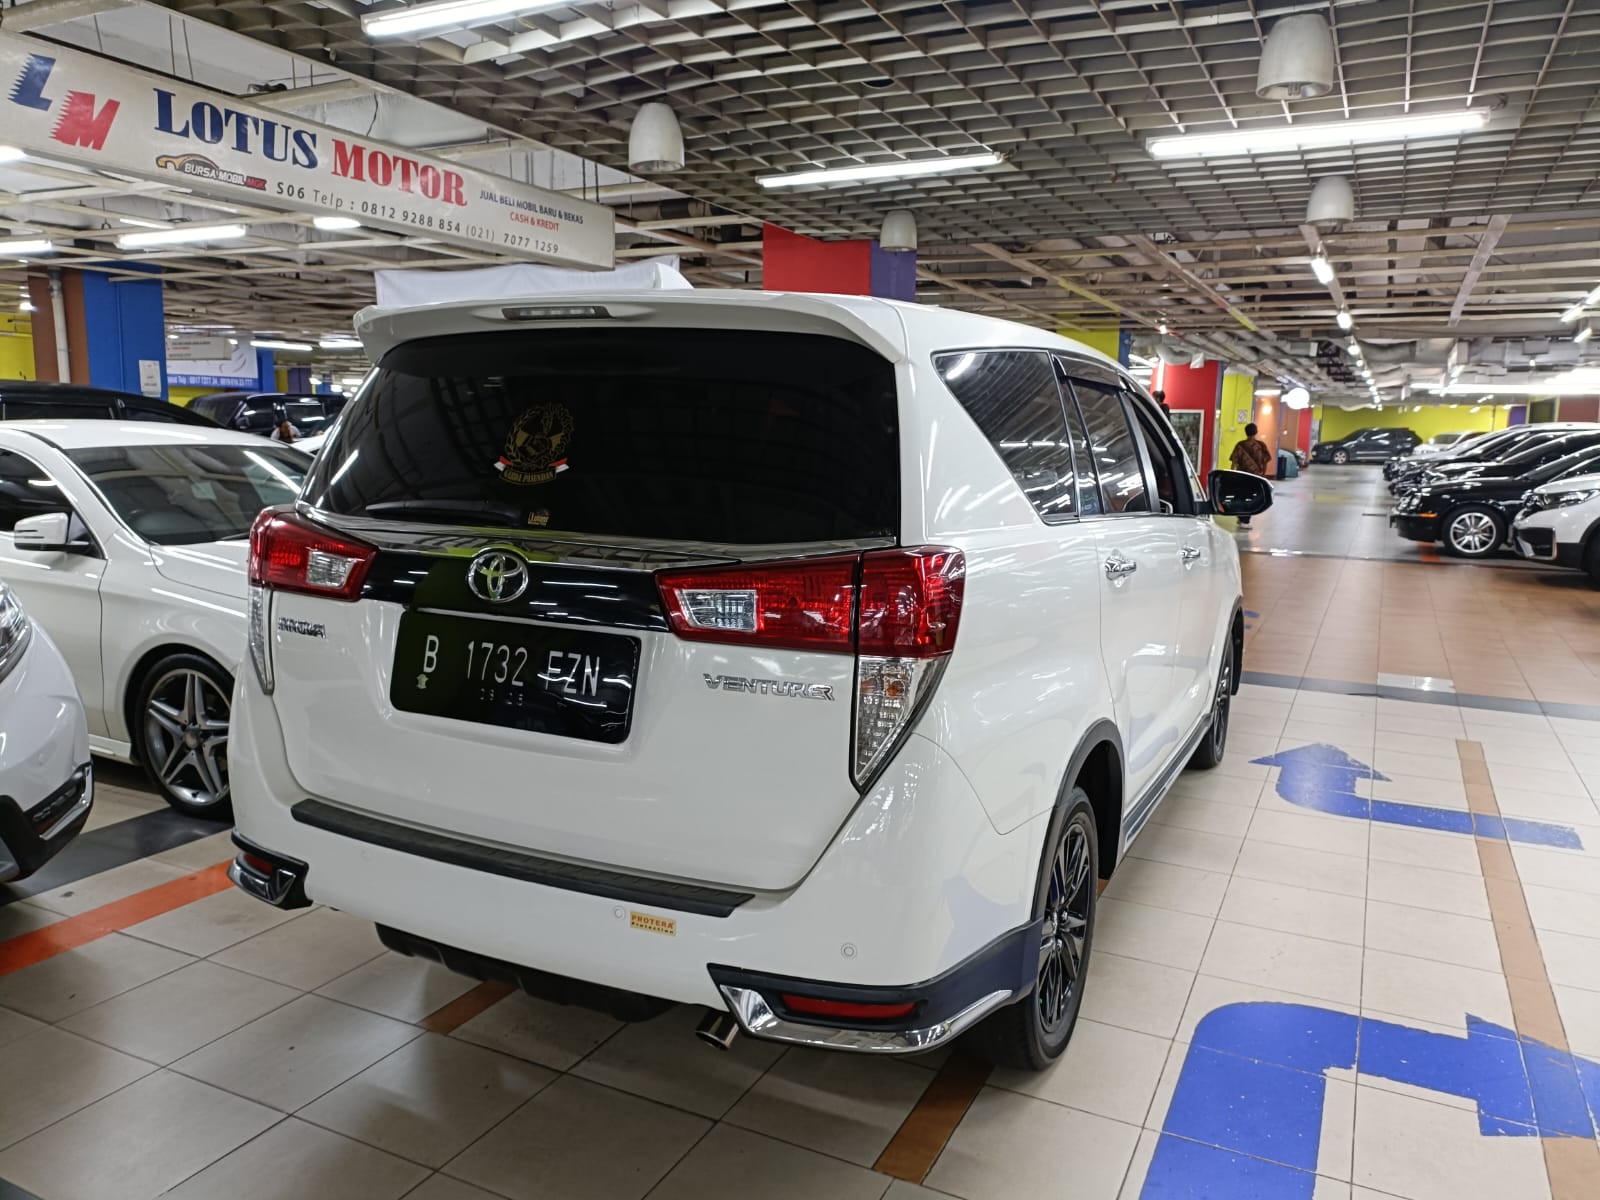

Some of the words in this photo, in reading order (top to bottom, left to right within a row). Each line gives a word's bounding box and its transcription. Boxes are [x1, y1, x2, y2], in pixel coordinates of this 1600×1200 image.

[153, 87, 318, 170] LOTUS
[331, 138, 468, 207] MOTOR
[184, 162, 217, 179] BURSA
[218, 169, 246, 186] MOBIL
[276, 181, 305, 199] S06
[313, 188, 343, 210] Telp
[361, 200, 395, 219] 0812
[402, 210, 433, 227] 9288
[438, 218, 461, 233] 854
[466, 225, 495, 242] (021)
[503, 233, 530, 248] 7077
[535, 239, 559, 254] 1259
[479, 190, 498, 202] JUAL
[500, 194, 515, 207] BELI
[516, 197, 538, 213] MOBIL
[539, 205, 558, 218] BARU
[558, 210, 563, 219] &
[563, 211, 584, 225] BEKAS
[509, 211, 529, 225] CASH
[529, 216, 535, 226] &
[536, 218, 560, 232] KREDIT
[422, 634, 440, 673] B
[467, 640, 528, 687] 1732
[545, 650, 601, 697] FZN
[702, 673, 835, 701] VENTURER
[631, 914, 675, 930] PROTERA
